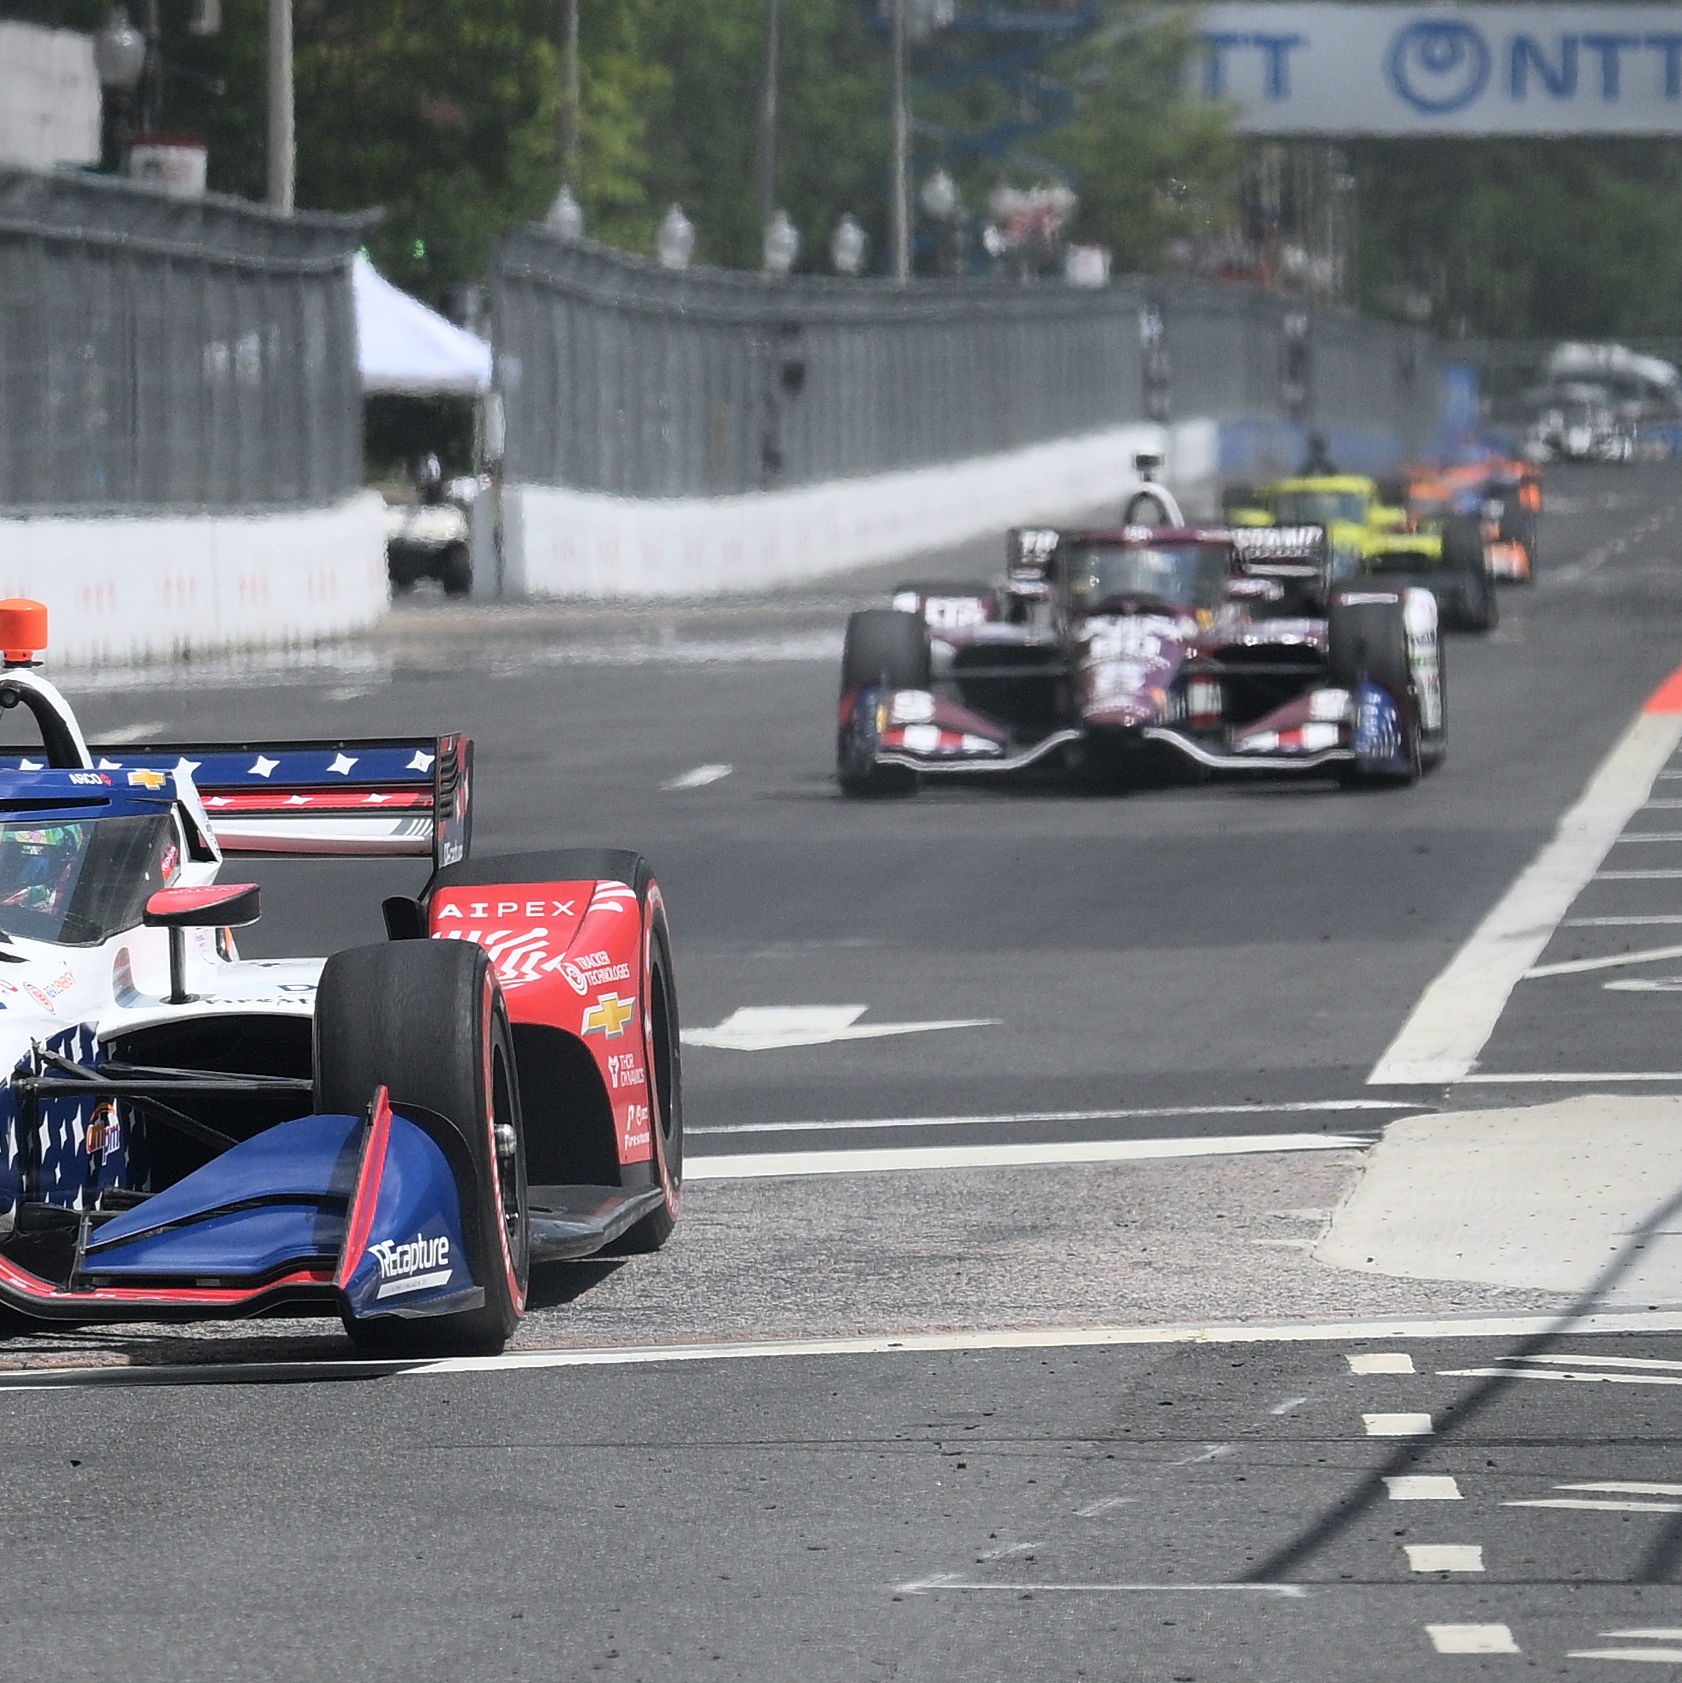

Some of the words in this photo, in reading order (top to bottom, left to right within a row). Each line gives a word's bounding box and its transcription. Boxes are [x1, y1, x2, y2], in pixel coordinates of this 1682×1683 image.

[68, 773, 101, 786] ARCO
[438, 900, 575, 919] AIPEX
[574, 950, 611, 970] TRACKER
[367, 1232, 449, 1279] REcapture
